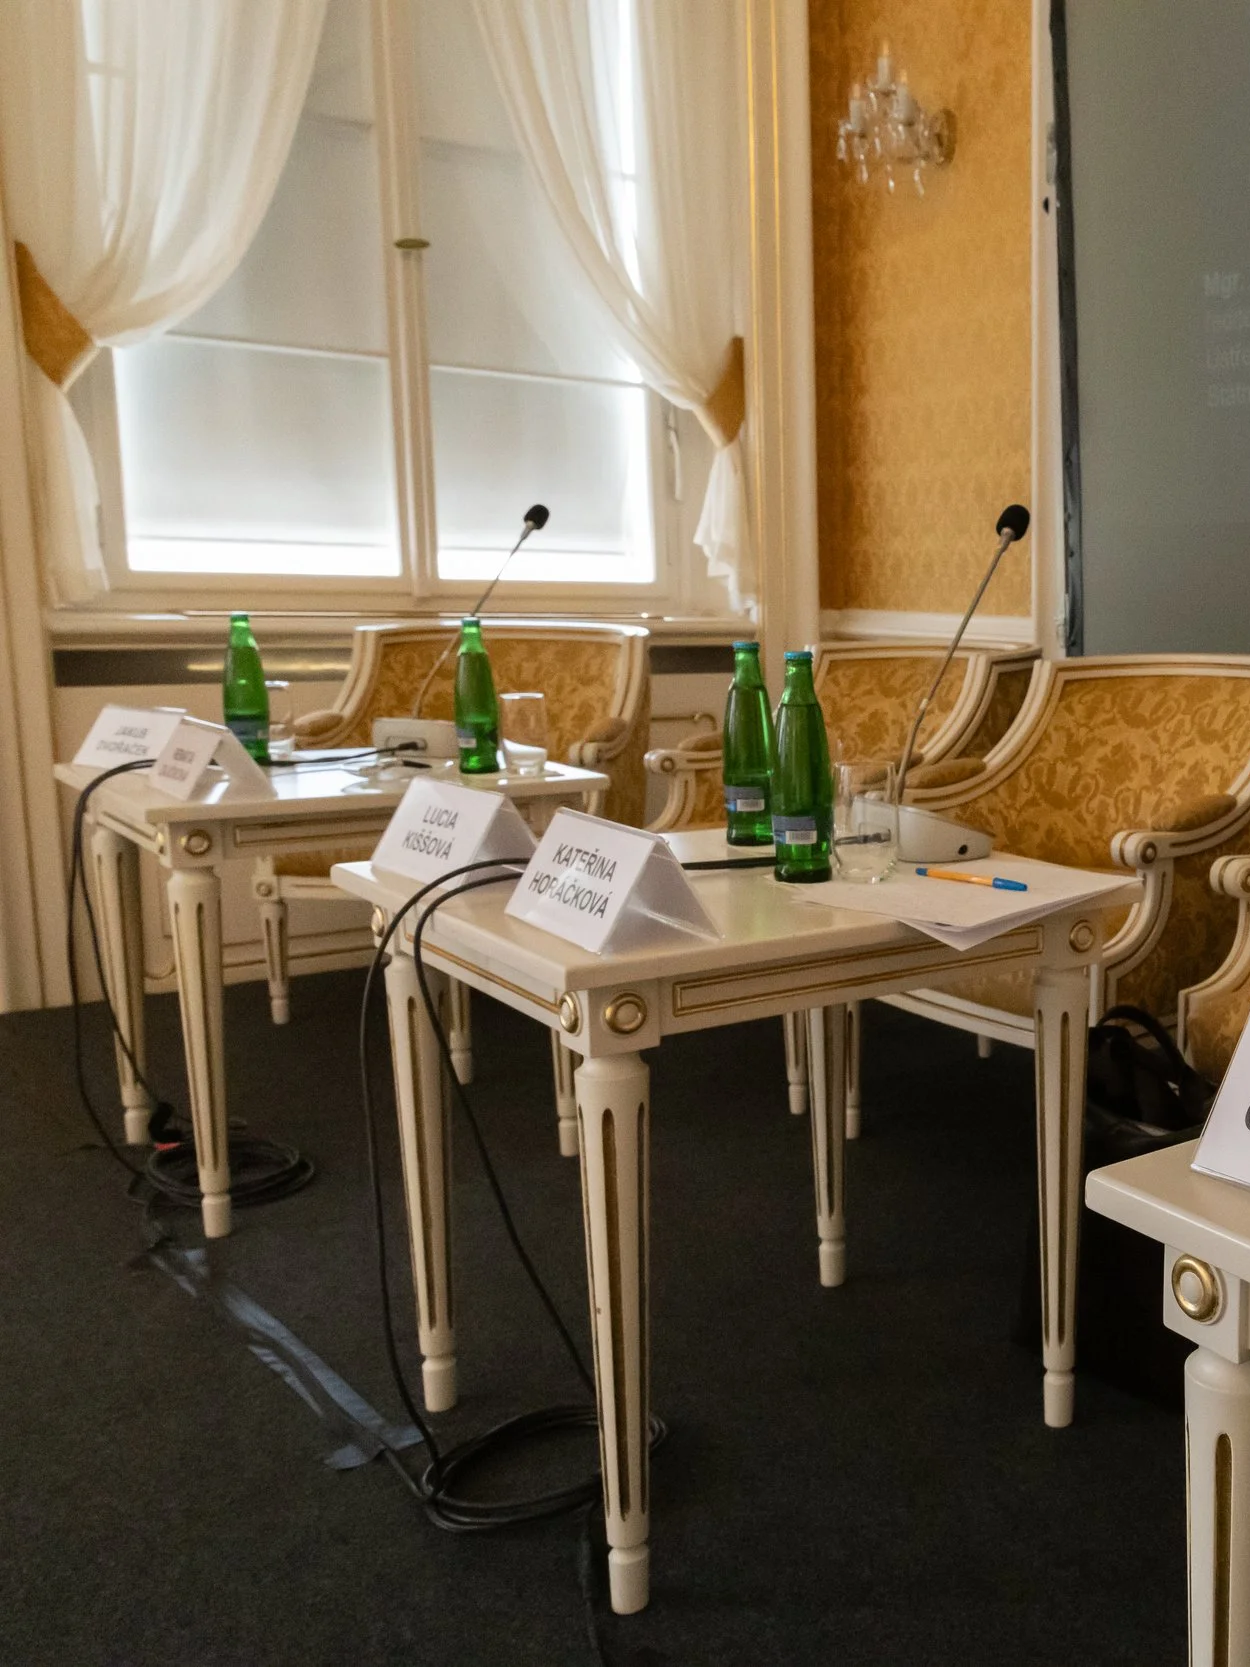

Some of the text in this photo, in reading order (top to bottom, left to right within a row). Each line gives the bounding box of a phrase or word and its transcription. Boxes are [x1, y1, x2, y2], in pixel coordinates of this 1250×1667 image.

[422, 805, 459, 831] LUCIA
[402, 829, 454, 861] KIŠŠOVÁ
[552, 842, 618, 883] KATEŘINA
[528, 870, 614, 919] HORÁČKOVÁ
